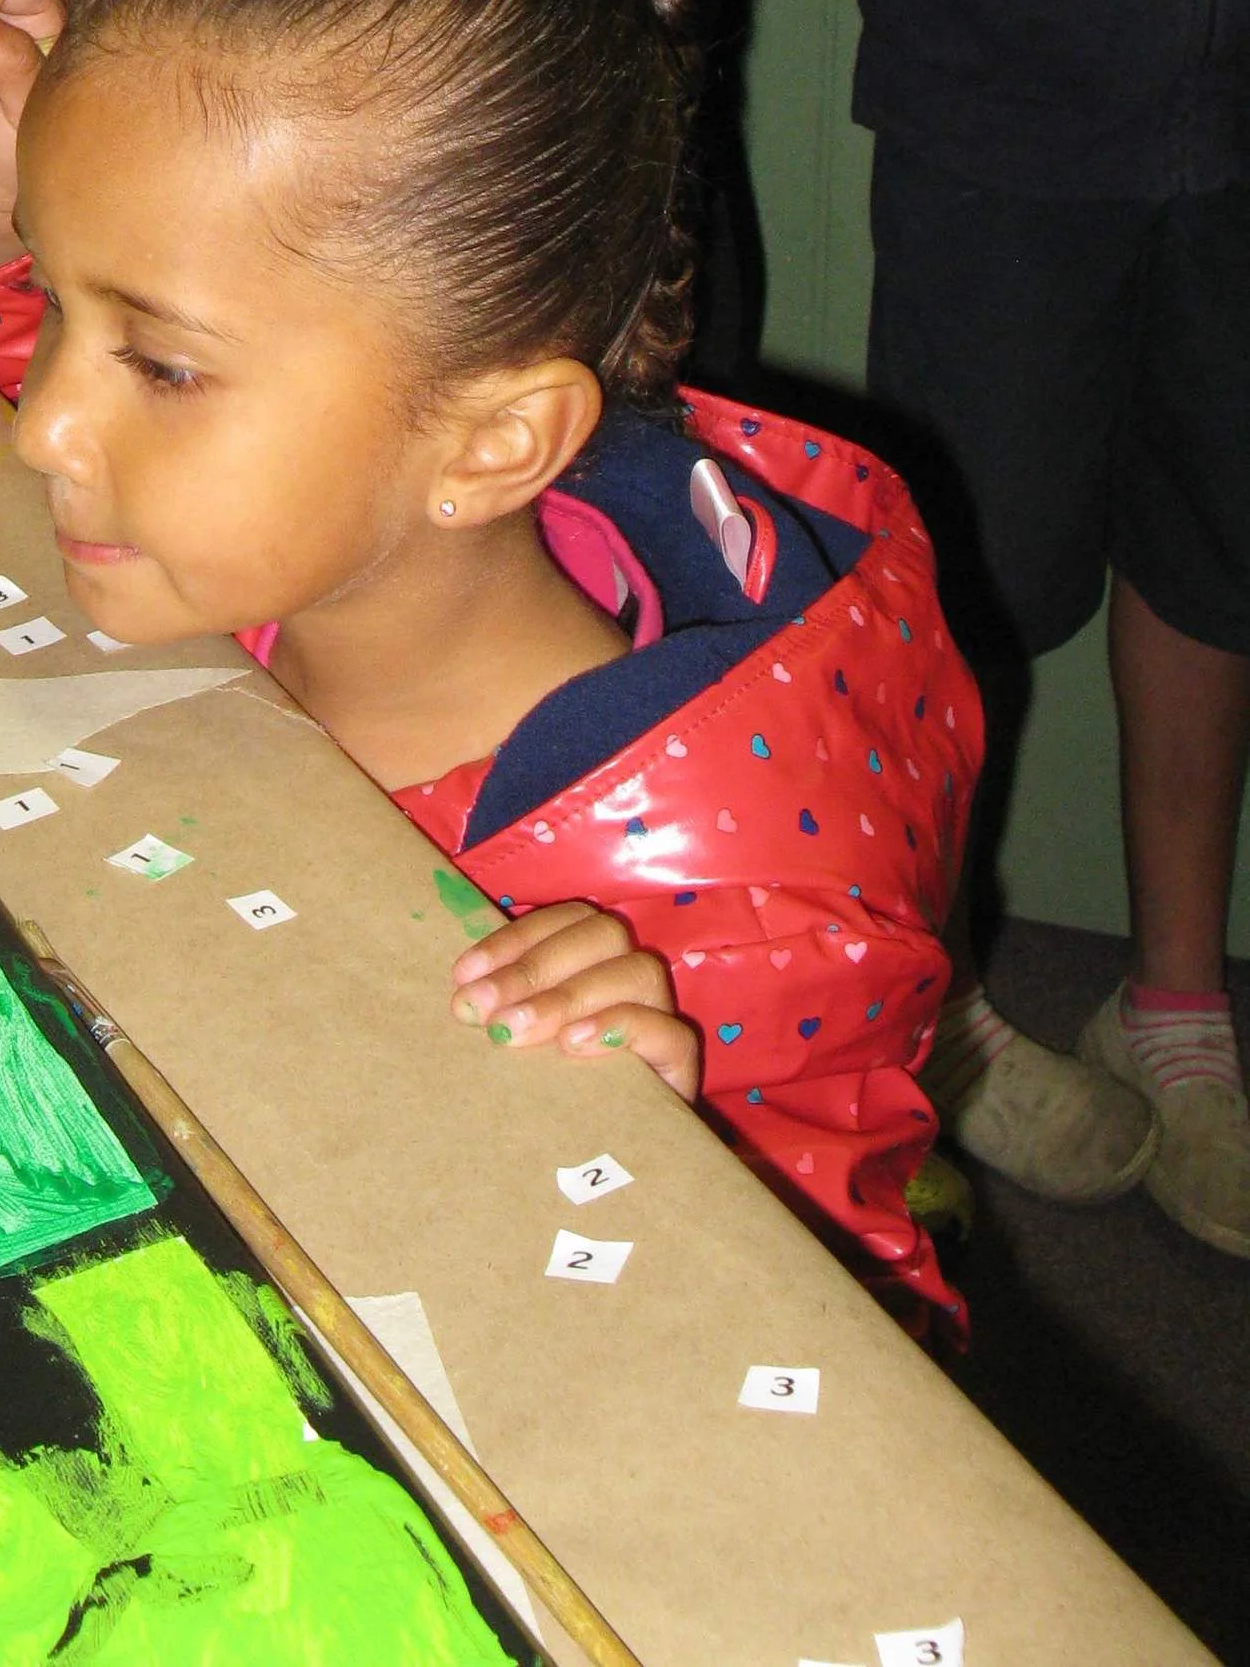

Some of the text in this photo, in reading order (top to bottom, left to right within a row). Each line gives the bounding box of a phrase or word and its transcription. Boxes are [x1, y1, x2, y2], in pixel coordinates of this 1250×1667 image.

[582, 1167, 610, 1188] 2
[566, 1251, 594, 1271] 2
[770, 1376, 796, 1397] 3
[915, 1639, 942, 1665] 3
